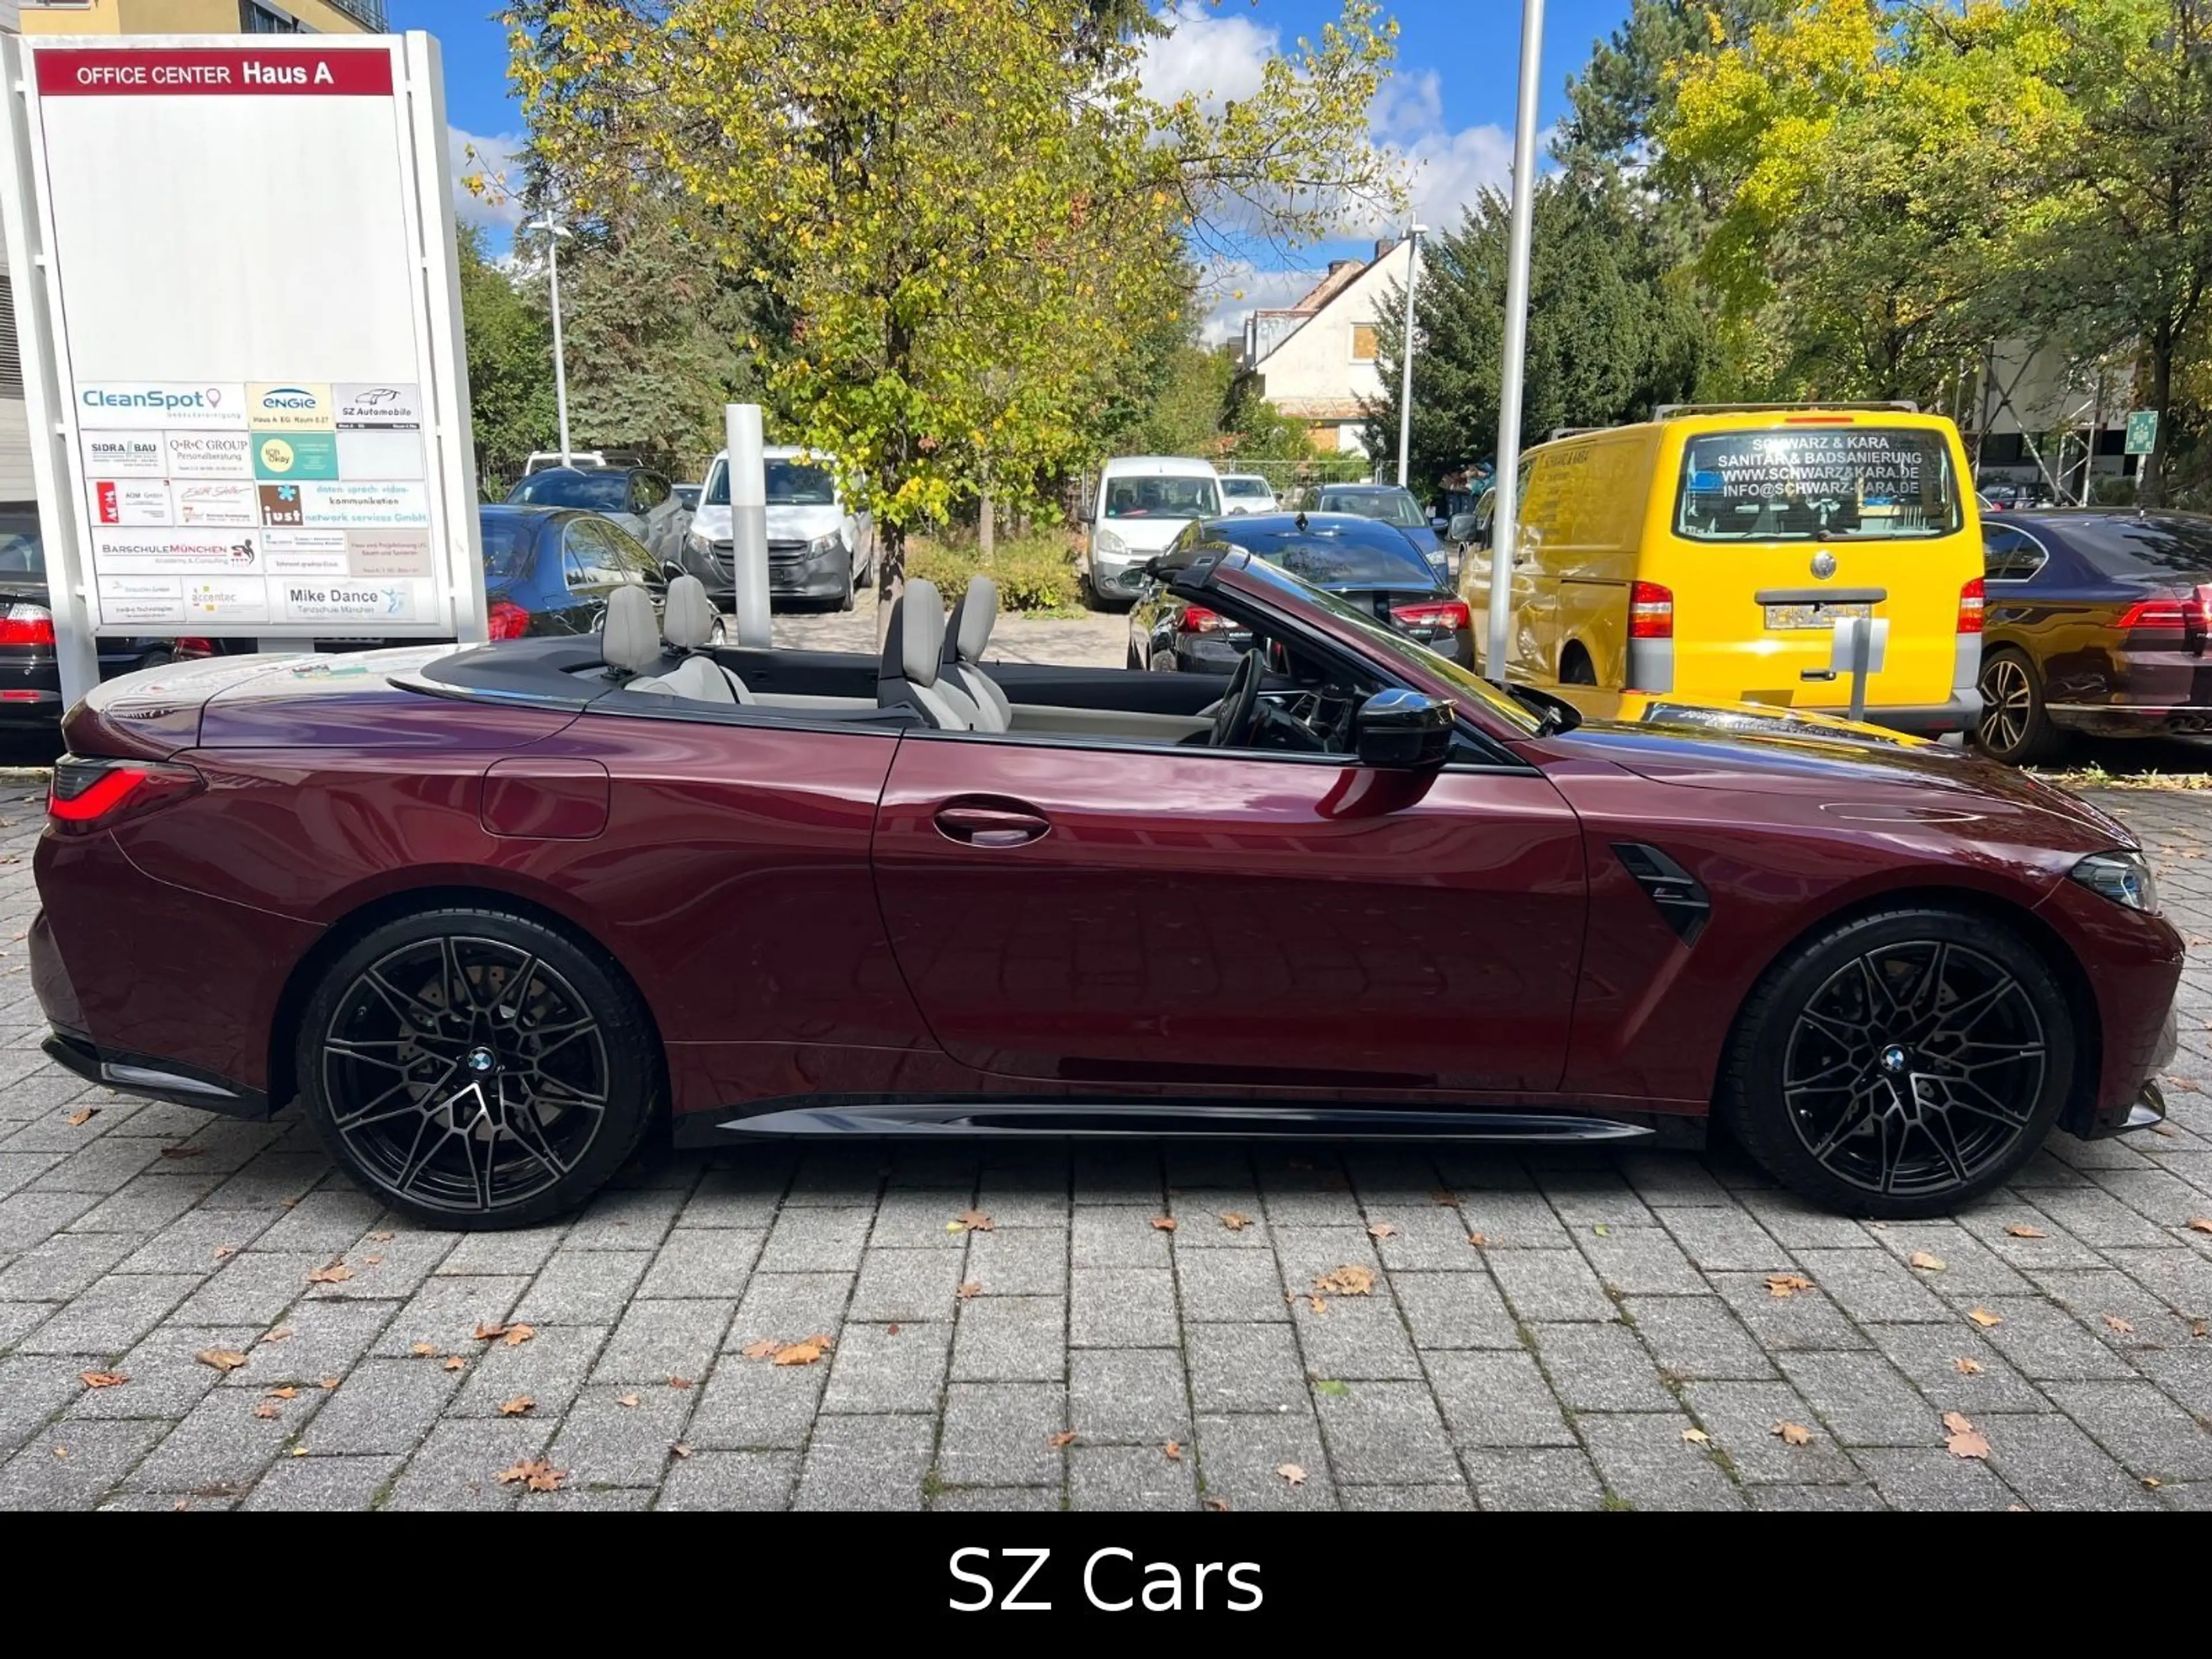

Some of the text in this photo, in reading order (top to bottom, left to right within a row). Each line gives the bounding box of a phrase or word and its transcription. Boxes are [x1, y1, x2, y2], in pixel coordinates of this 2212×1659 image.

[77, 61, 334, 85] OFFICE CENTER Haus A
[83, 390, 204, 410] CleanSpot
[91, 444, 156, 452] SIDRA BAU
[206, 440, 248, 450] GROUP
[1752, 437, 1889, 450] SCWARZ & KARA
[1790, 452, 1801, 464] &
[1805, 452, 1922, 464] BADSANIERUNG
[329, 497, 399, 505] kommunikation
[263, 506, 301, 525] just
[305, 512, 427, 522] network services GmbH
[290, 589, 378, 603] Mike Dance
